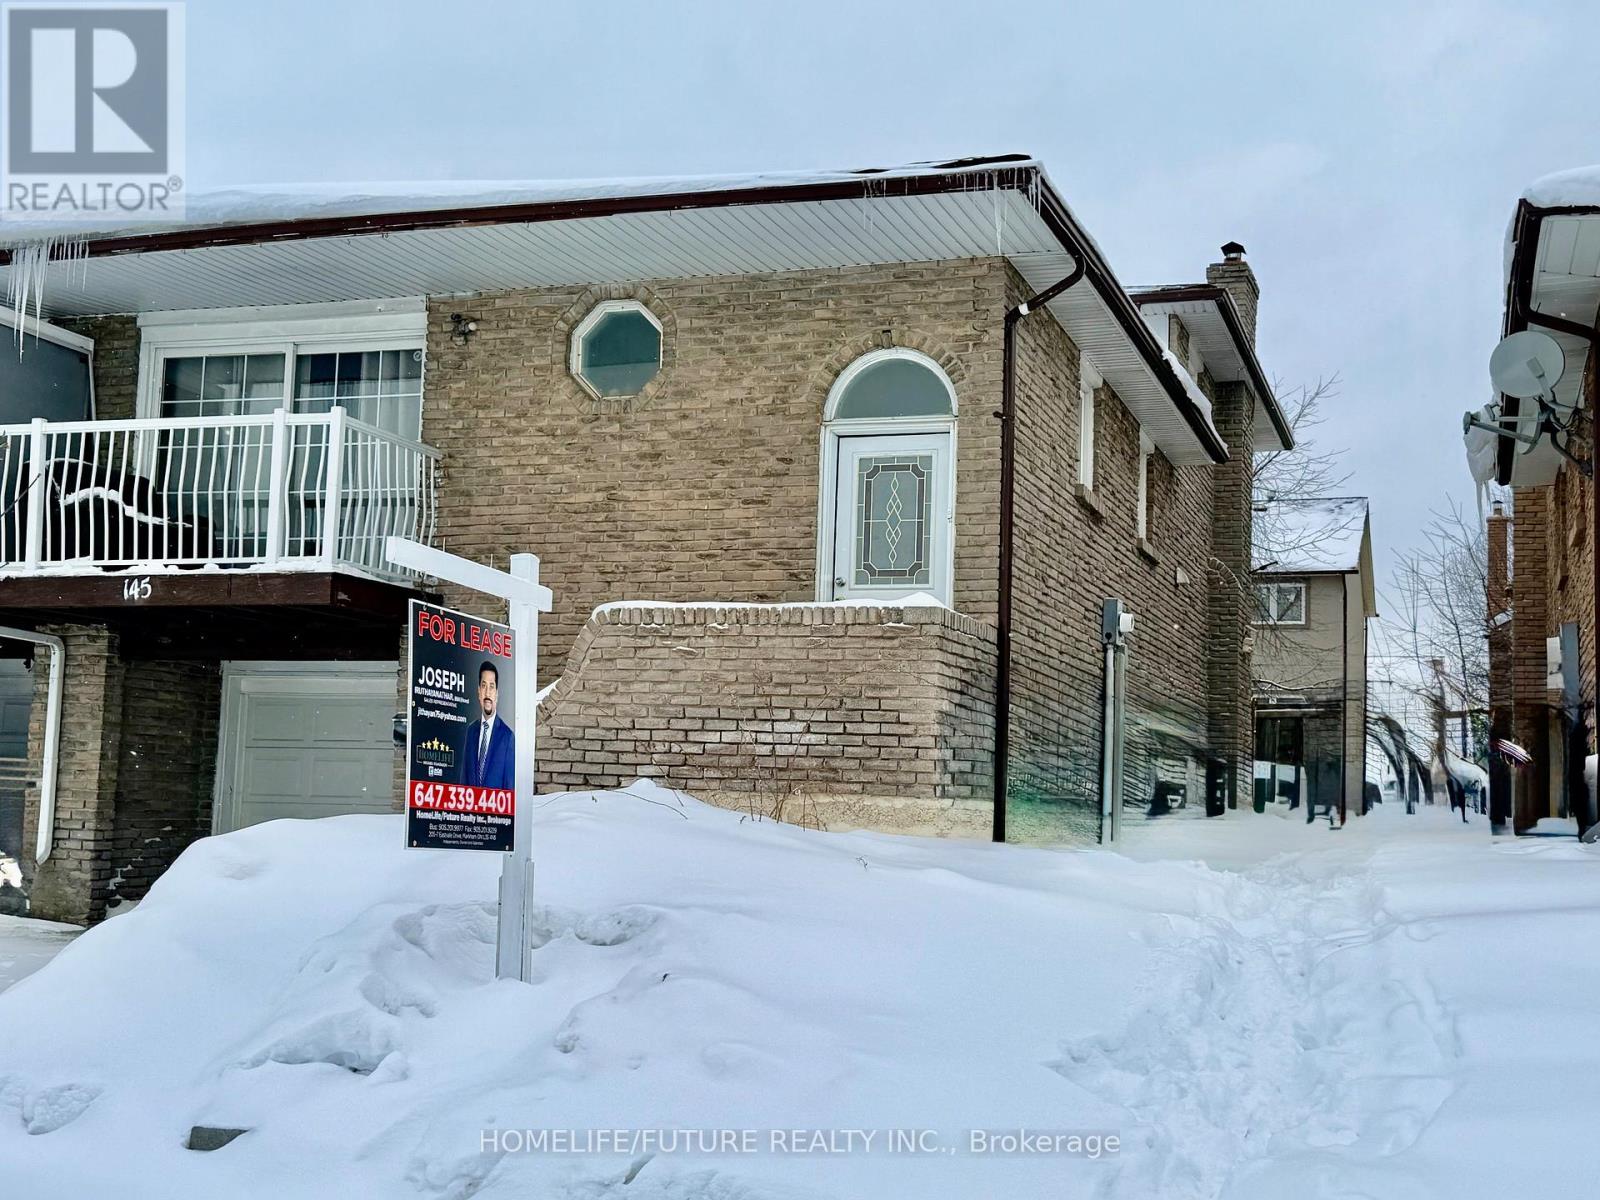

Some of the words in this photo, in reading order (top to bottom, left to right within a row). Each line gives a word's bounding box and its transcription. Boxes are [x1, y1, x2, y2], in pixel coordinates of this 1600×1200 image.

[123, 576, 152, 600] 145
[418, 611, 456, 645] FOR
[460, 622, 512, 660] LEASE
[418, 665, 465, 693] JOSEPH
[414, 782, 512, 814] 647.339.4401
[460, 813, 476, 824] Realty
[487, 815, 512, 826] Brokerage
